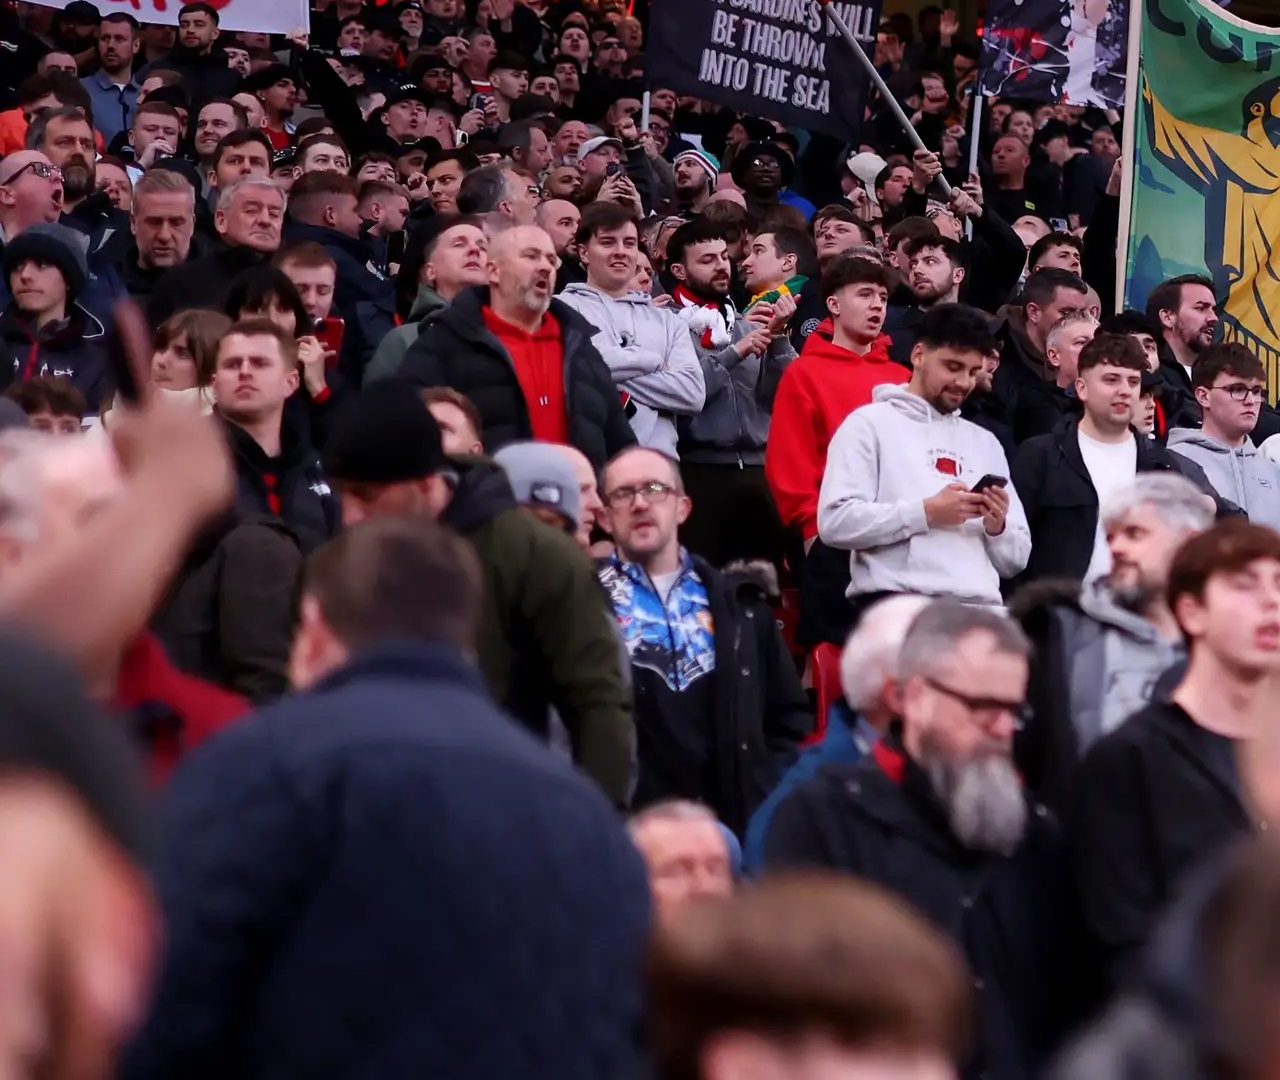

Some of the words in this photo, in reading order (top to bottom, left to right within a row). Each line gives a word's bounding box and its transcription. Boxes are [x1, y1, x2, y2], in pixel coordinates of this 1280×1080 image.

[710, 9, 739, 49] BE
[698, 48, 750, 92] INTO
[752, 62, 792, 103] THE
[791, 73, 831, 115] SEA
